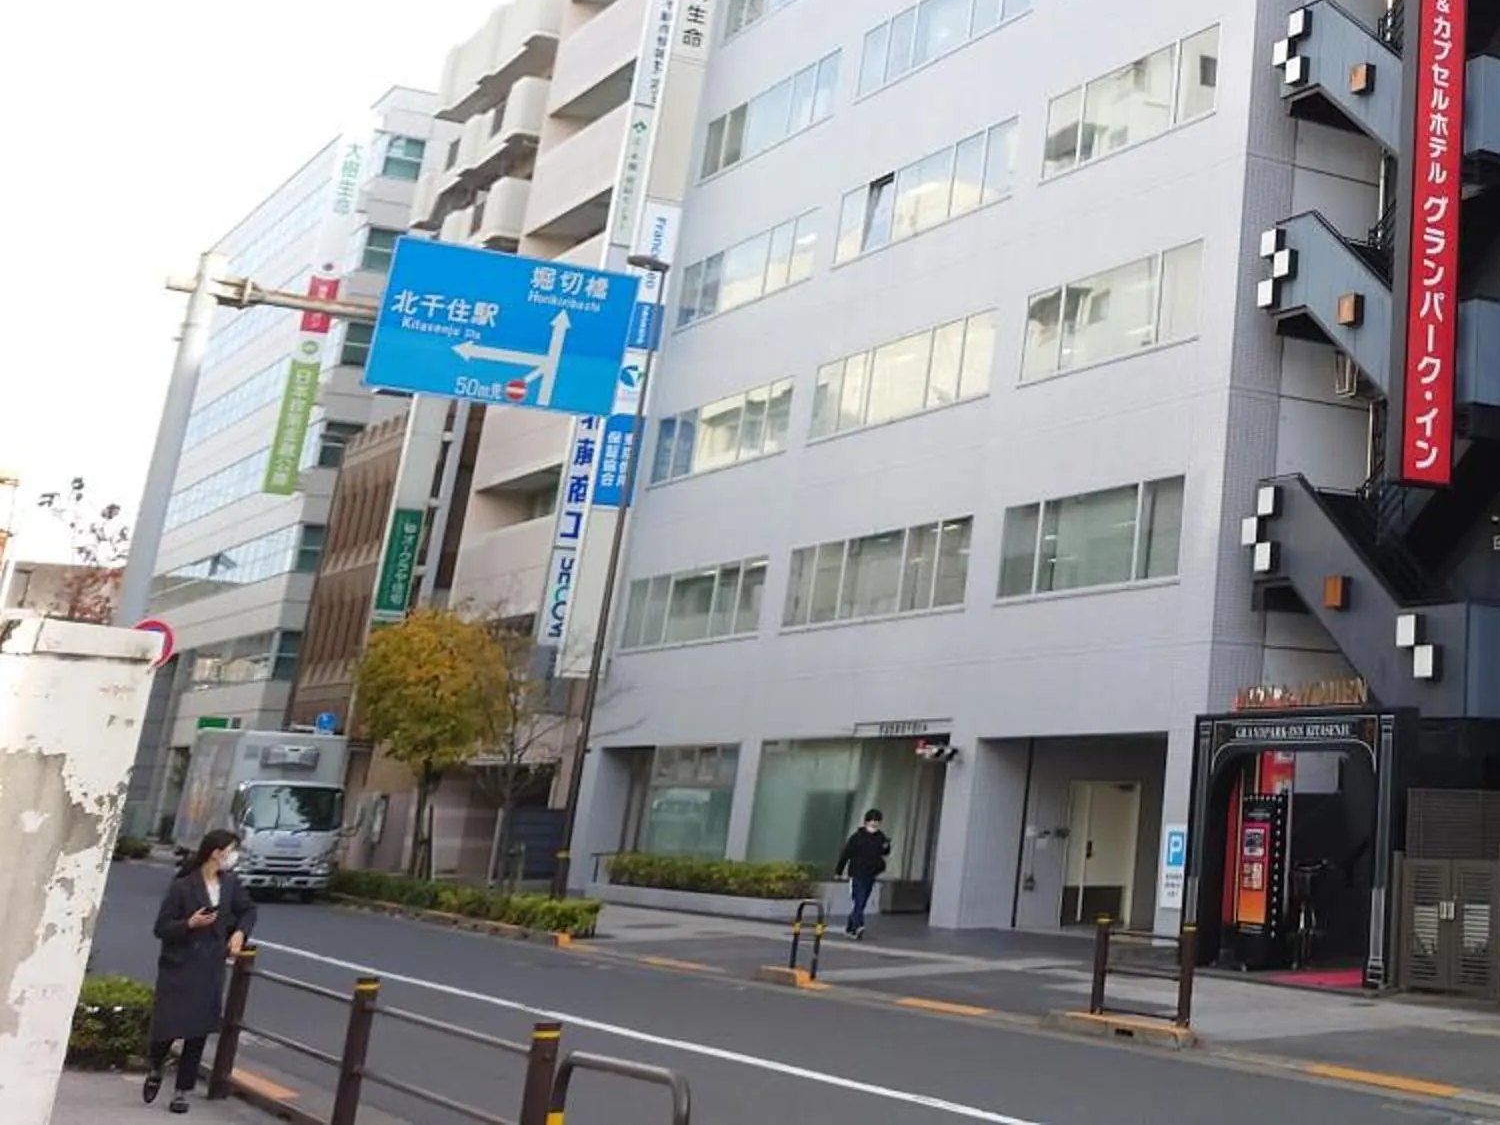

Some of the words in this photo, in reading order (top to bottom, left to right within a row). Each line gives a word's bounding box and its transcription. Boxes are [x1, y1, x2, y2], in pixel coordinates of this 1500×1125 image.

[530, 266, 608, 300] 堀切橋
[391, 288, 499, 328] 北千住駅
[1415, 195, 1449, 470] グランパーク・イン
[1169, 834, 1183, 865] P
